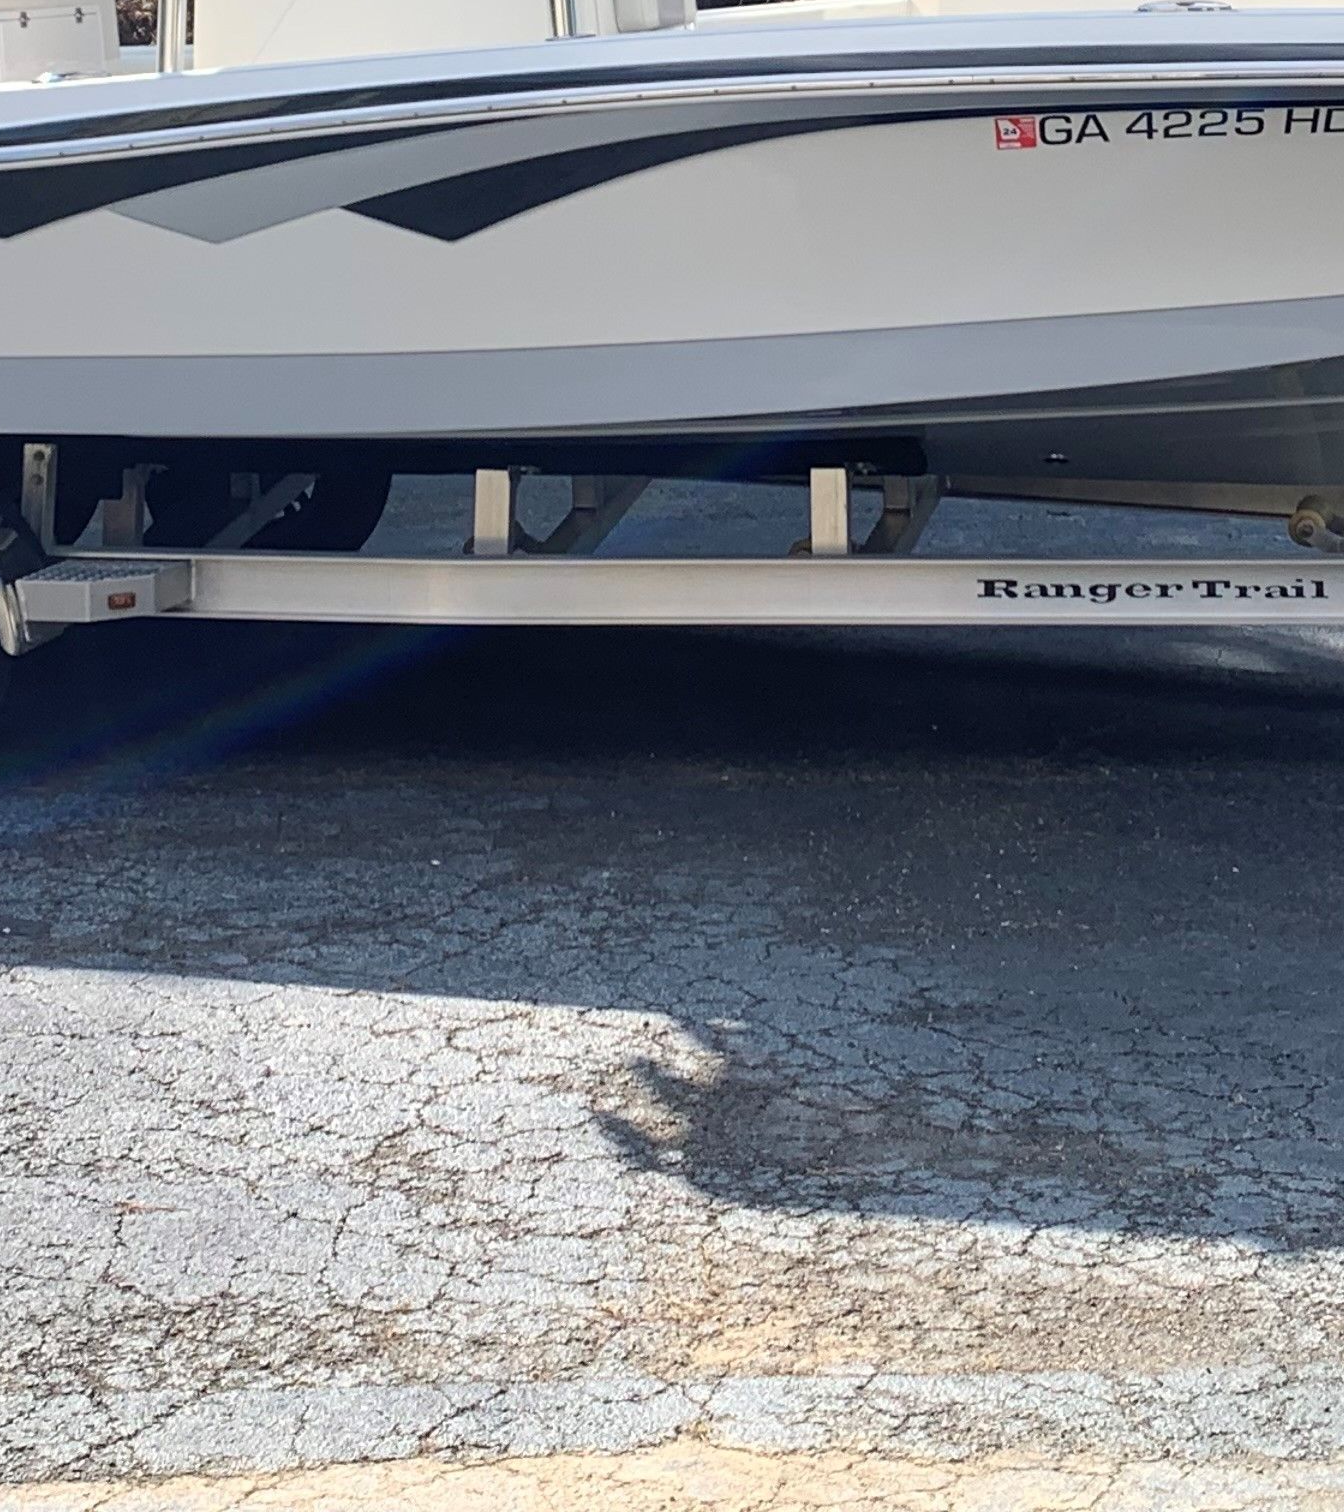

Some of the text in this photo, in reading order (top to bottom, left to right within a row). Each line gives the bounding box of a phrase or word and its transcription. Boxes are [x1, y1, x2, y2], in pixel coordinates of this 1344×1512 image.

[1002, 128, 1017, 136] 24
[1039, 114, 1110, 145] GA
[1125, 108, 1265, 139] 4225
